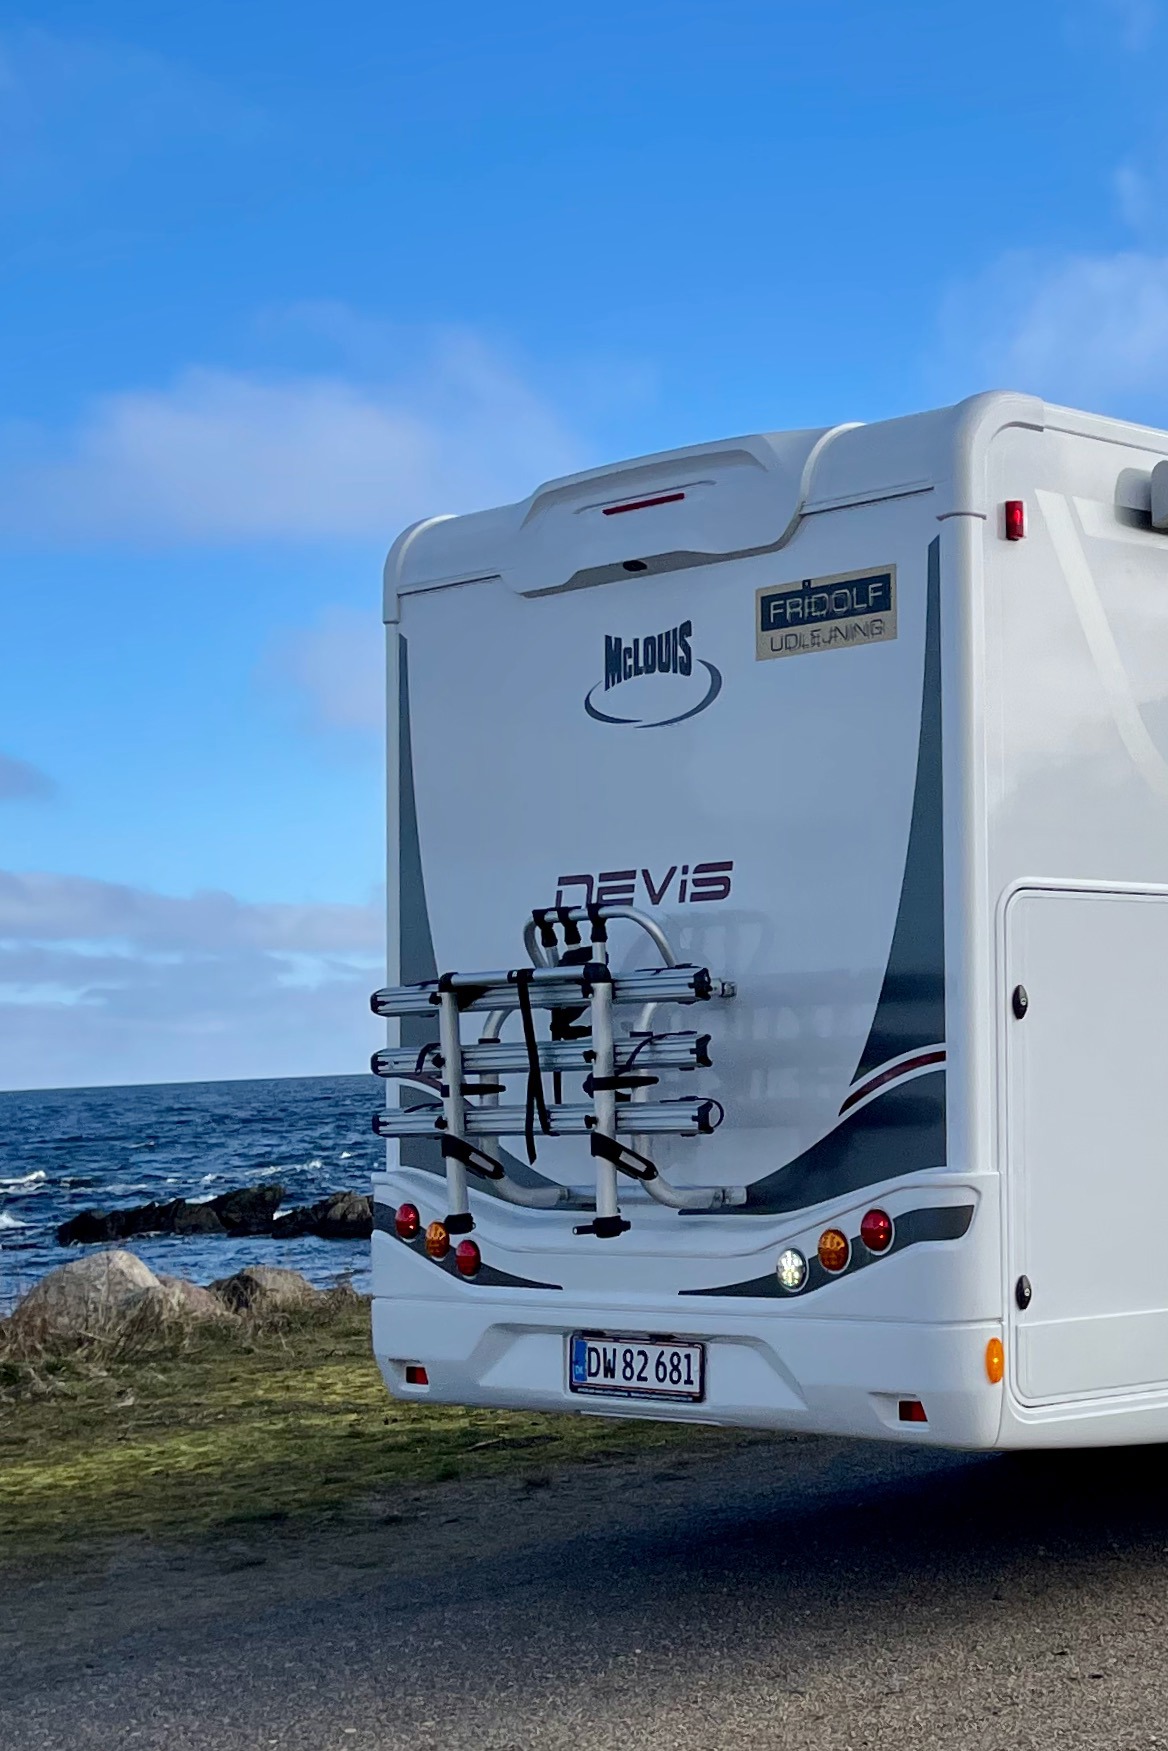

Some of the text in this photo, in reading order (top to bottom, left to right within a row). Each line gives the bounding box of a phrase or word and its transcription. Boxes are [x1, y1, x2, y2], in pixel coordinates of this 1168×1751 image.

[769, 582, 884, 624] FRIDOLF
[604, 619, 692, 692] McLOUIS
[587, 1346, 694, 1386] DW 82 681
